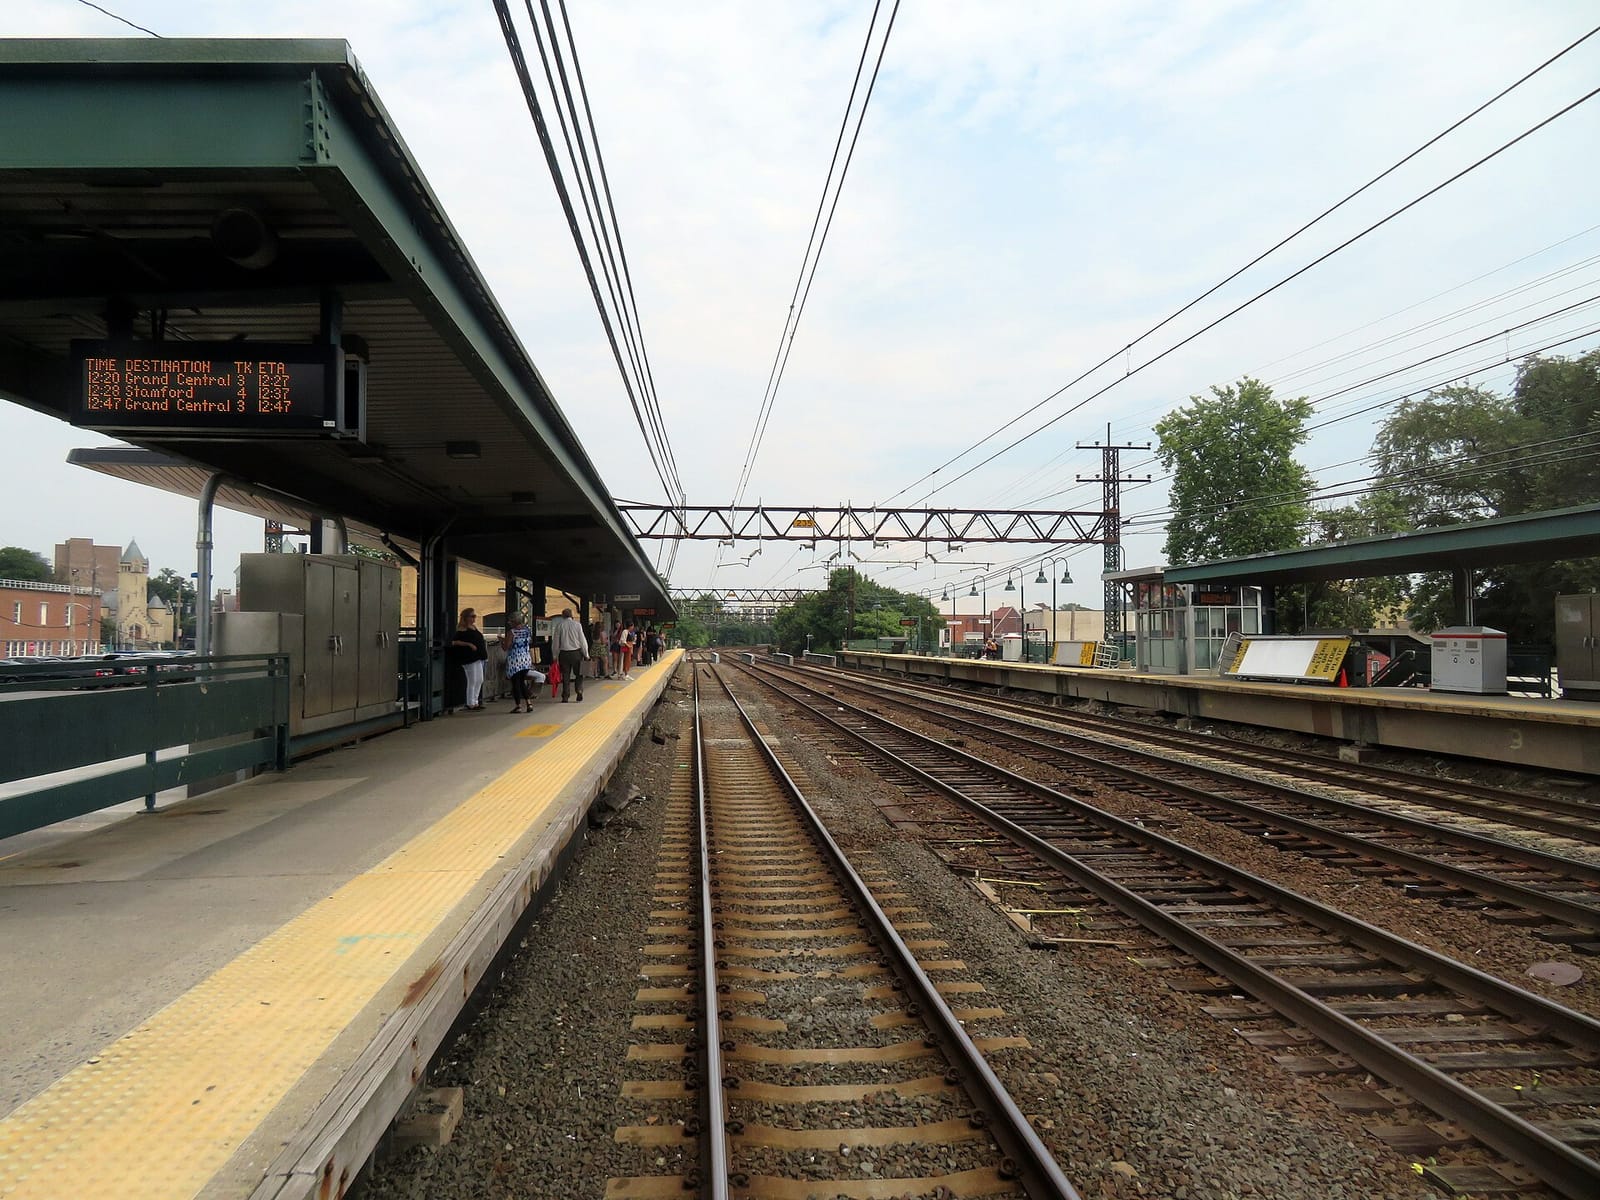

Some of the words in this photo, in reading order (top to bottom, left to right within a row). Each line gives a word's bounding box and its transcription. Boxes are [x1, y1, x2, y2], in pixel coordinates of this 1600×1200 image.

[86, 358, 117, 372] TIME
[125, 359, 211, 373] DESTINATION
[234, 361, 252, 374] TK
[258, 362, 285, 374] ETA
[88, 371, 120, 384] 12:20
[125, 372, 168, 385] Grand
[177, 373, 230, 386] Central
[237, 374, 246, 386] 3
[258, 374, 290, 387] 12:27
[88, 384, 120, 397] 12:28
[125, 385, 194, 399] Stamford
[237, 387, 247, 399] 4
[258, 387, 290, 400] 12:37
[88, 397, 121, 410] 12:47
[125, 398, 168, 411] Grand
[177, 399, 230, 412] Central
[237, 400, 246, 412] 3
[258, 399, 291, 413] 12:47
